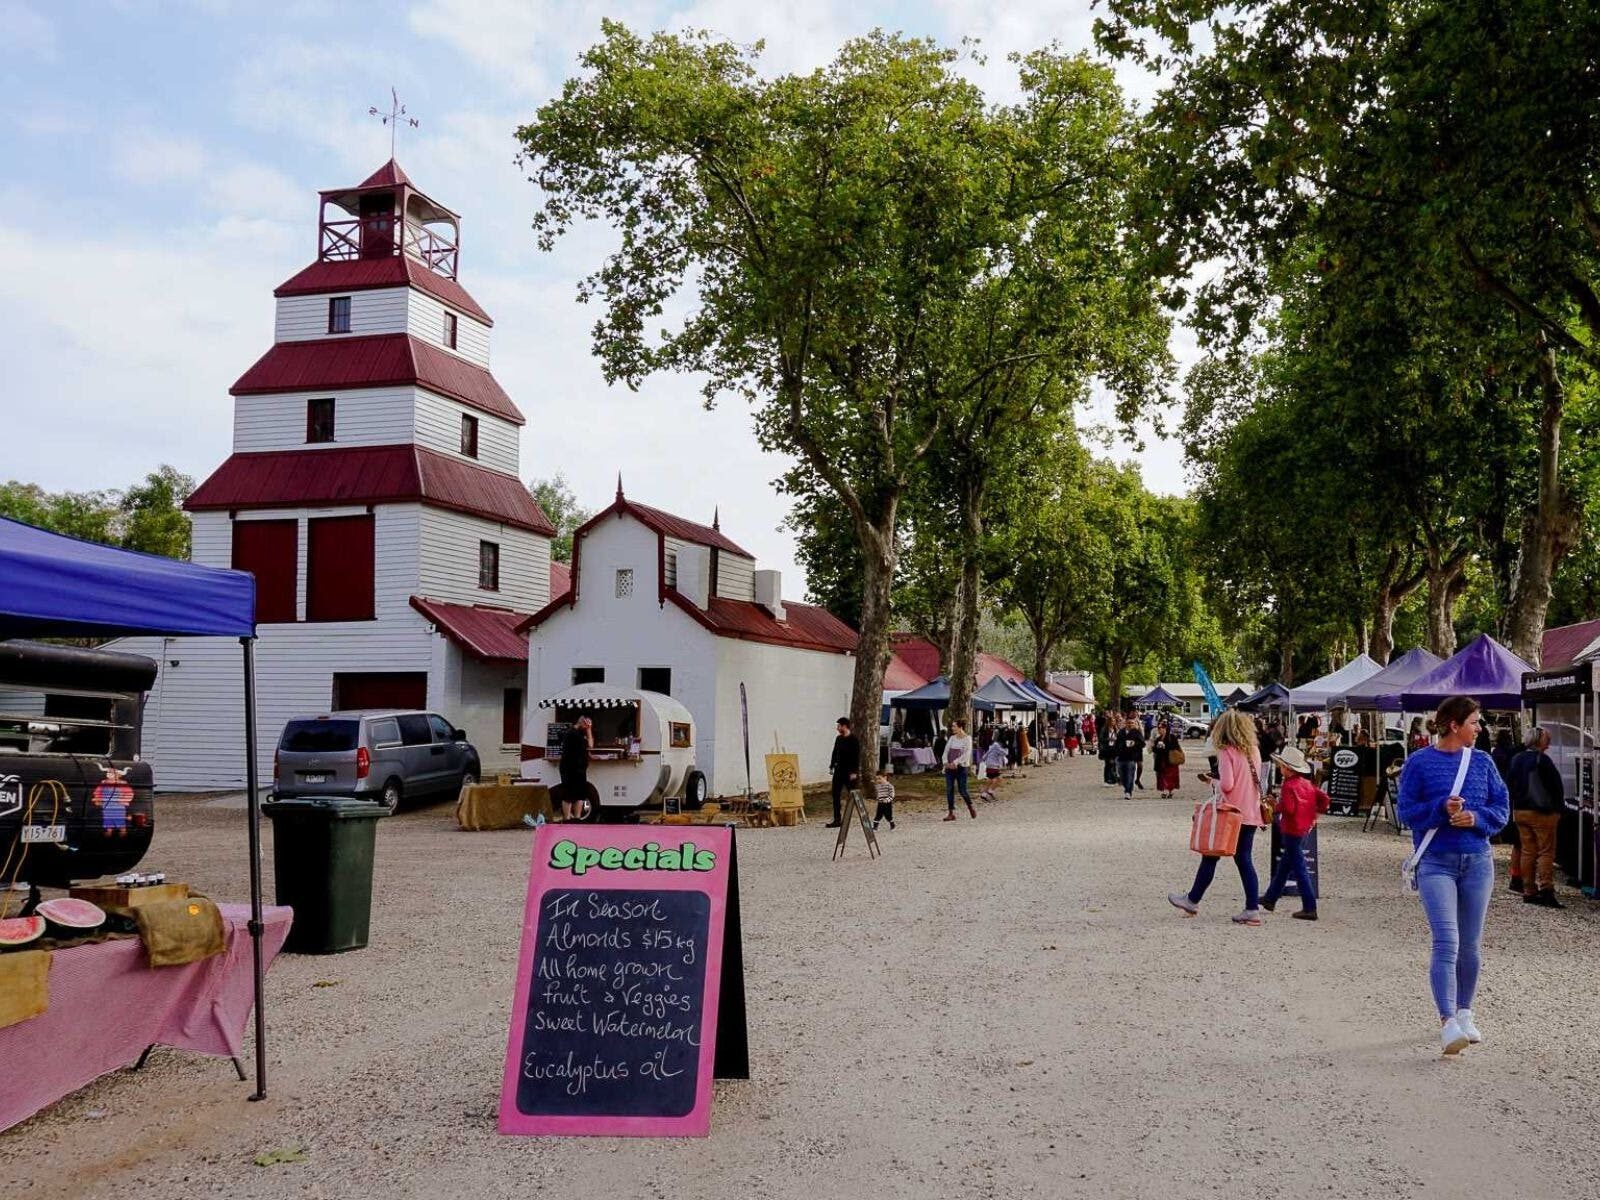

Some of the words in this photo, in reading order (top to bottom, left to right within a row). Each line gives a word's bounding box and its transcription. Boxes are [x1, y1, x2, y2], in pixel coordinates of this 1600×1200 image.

[548, 839, 716, 875] Specials
[547, 893, 580, 920] In
[587, 893, 668, 920] Season
[546, 922, 632, 951] Almonds
[538, 957, 561, 980] All
[566, 954, 607, 980] home
[612, 962, 683, 989] grown
[622, 983, 691, 1018] Veggies
[535, 1011, 587, 1032] Sweet
[593, 1010, 700, 1046] Watermelon
[524, 1050, 630, 1095] Eucalyptus
[639, 1044, 684, 1081] oil
